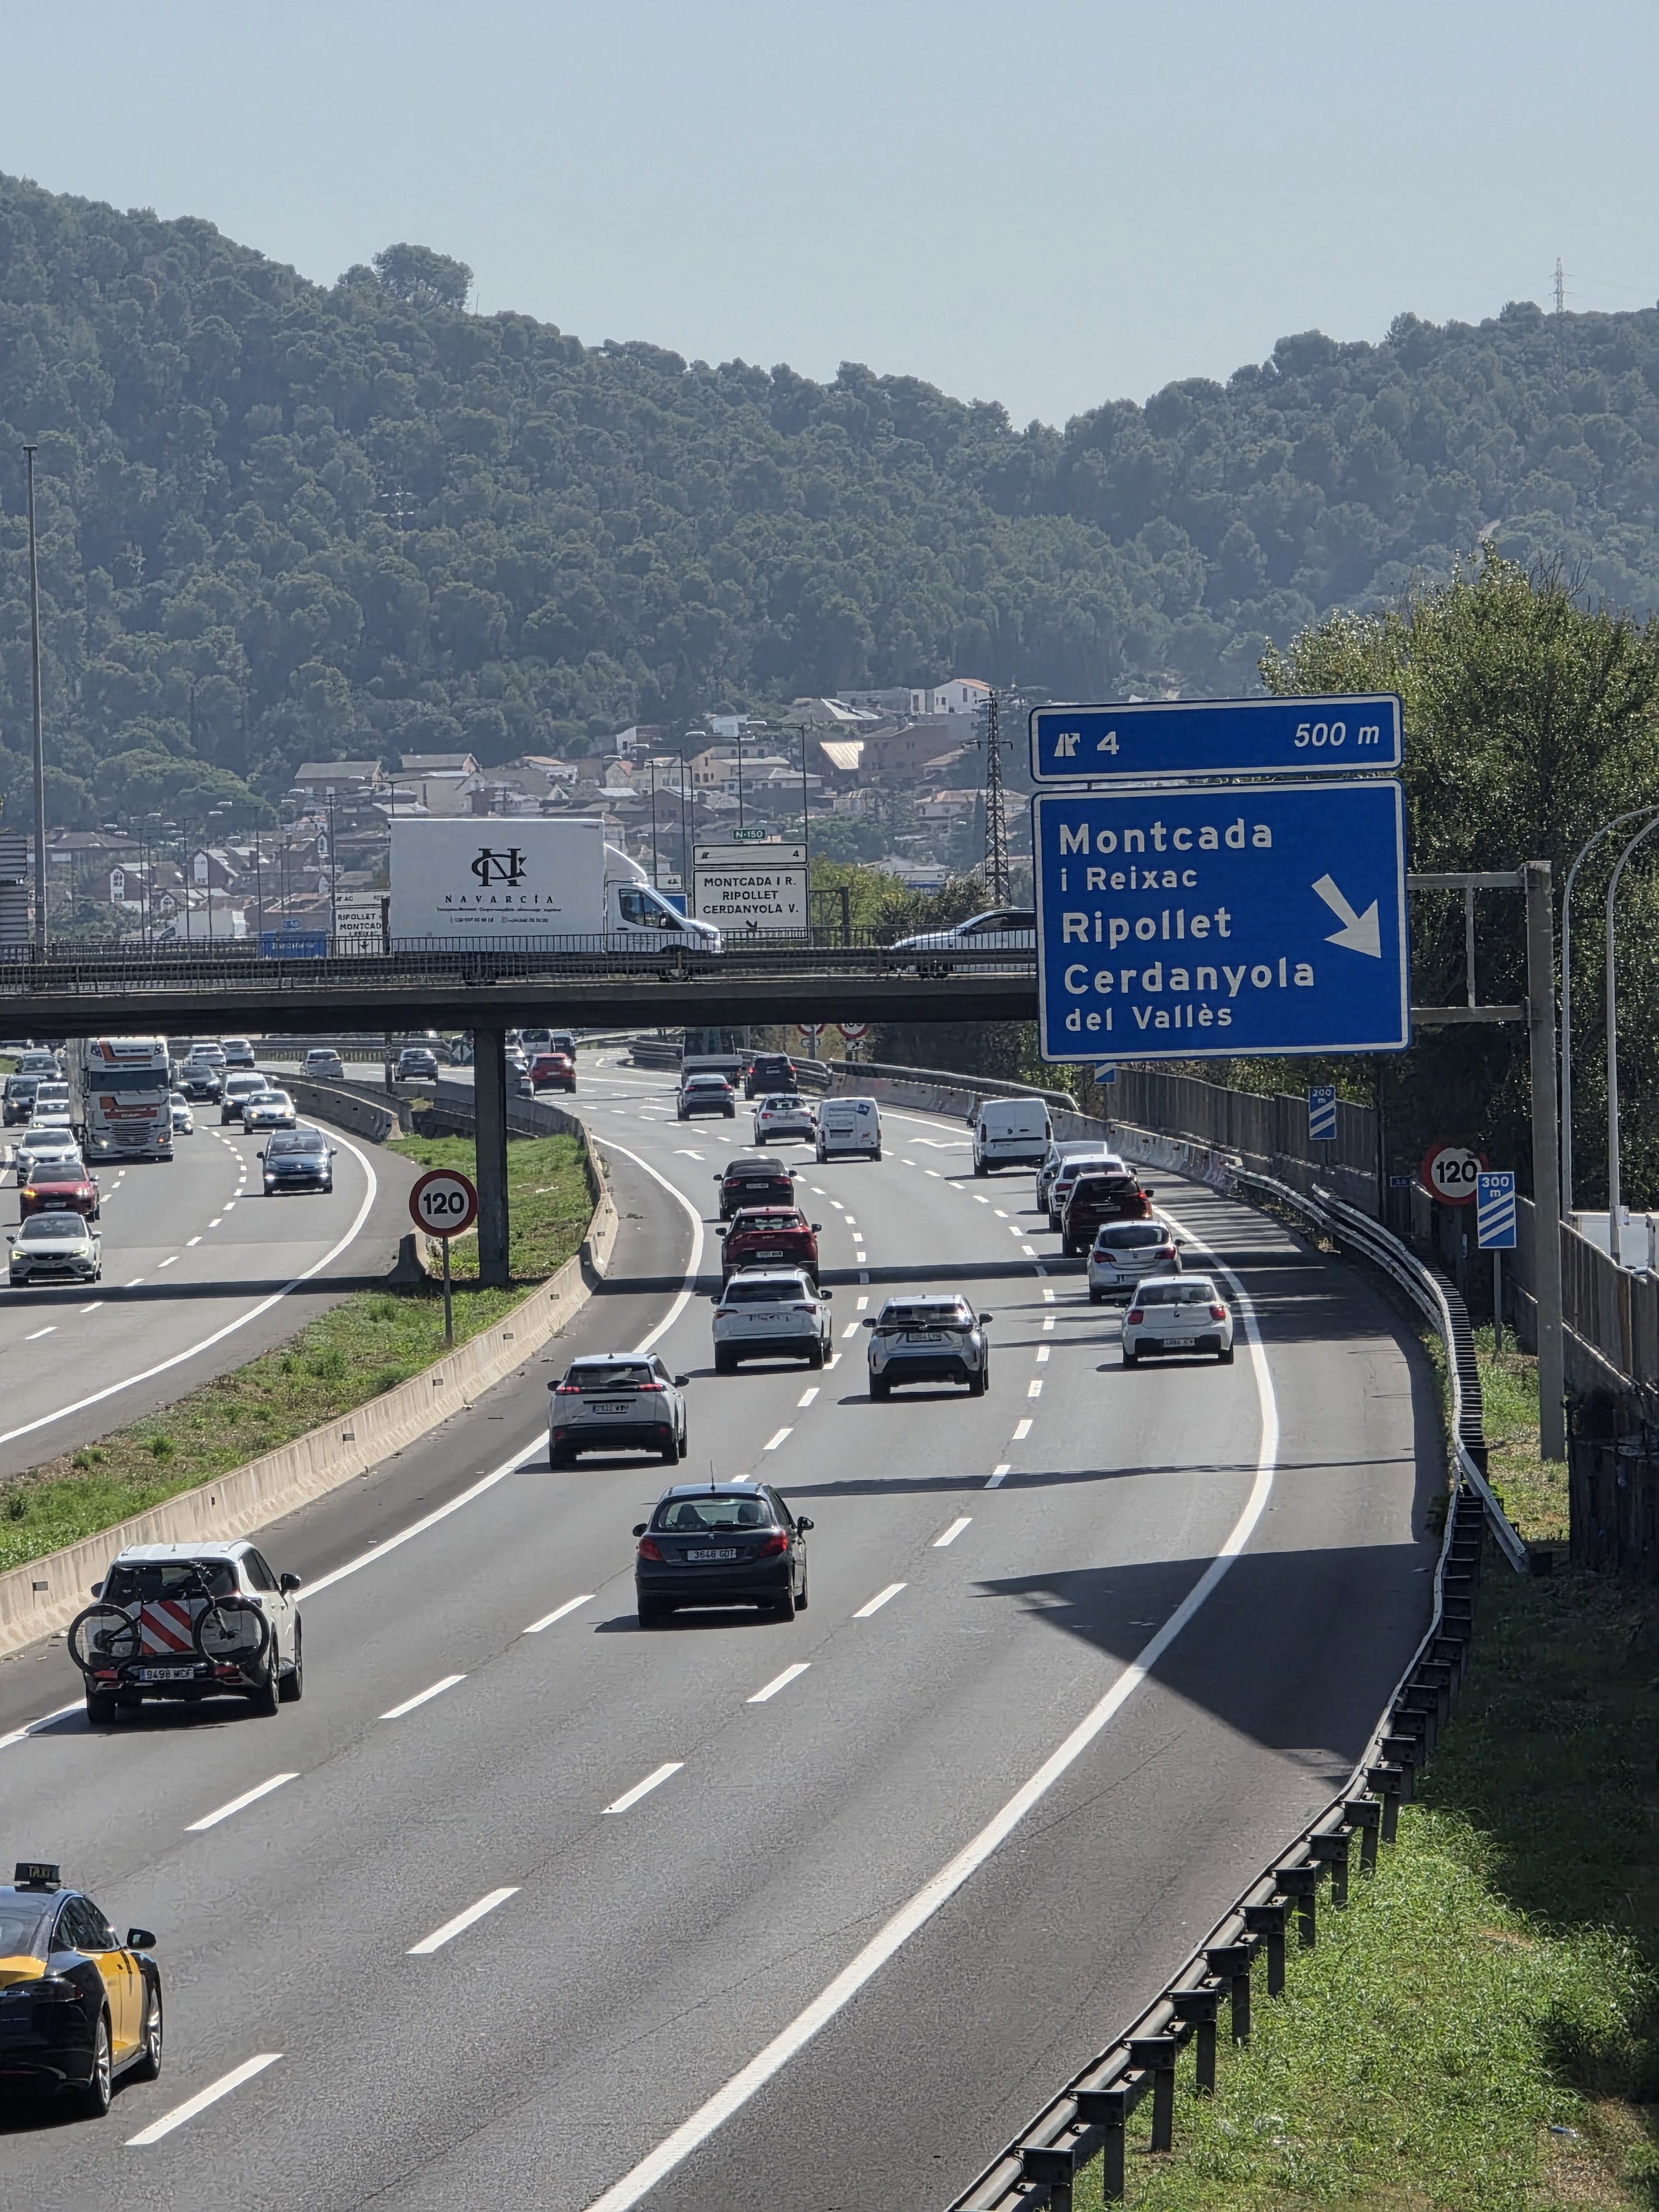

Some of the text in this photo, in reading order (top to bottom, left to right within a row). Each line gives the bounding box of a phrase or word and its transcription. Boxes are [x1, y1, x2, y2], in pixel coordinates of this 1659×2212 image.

[1097, 722, 1379, 755] 4 500 m
[1060, 818, 1272, 855] Montcada
[704, 877, 772, 887] MONTCADA
[785, 877, 796, 885] R.
[1061, 867, 1197, 891] i Reixac
[445, 894, 553, 903] NAVARCÍA
[723, 891, 778, 900] RIPOLLET
[703, 904, 799, 914] CERDANYOLA V.
[1063, 907, 1231, 950] Ripollet
[1065, 957, 1314, 997] Cerdanyola
[1066, 1003, 1233, 1032] del Vallès
[1436, 1160, 1478, 1183] 120
[1482, 1177, 1509, 1187] 300
[424, 1192, 465, 1214] 120
